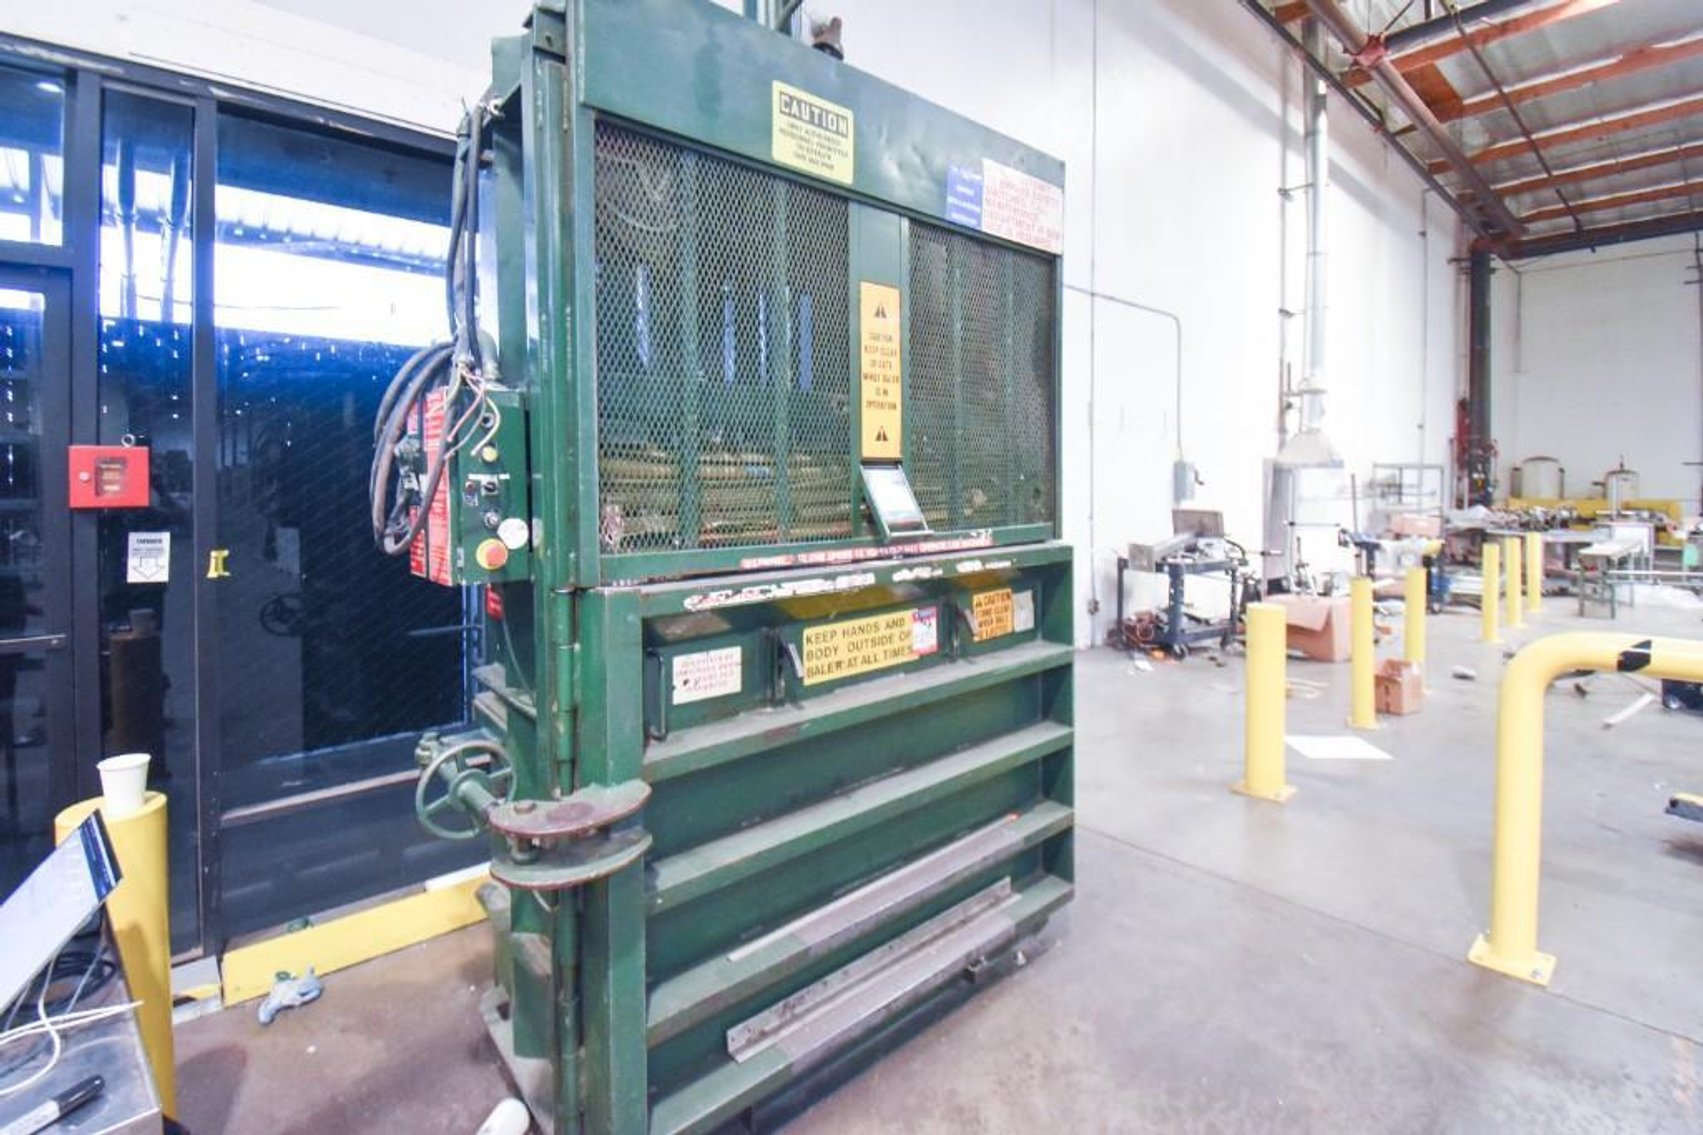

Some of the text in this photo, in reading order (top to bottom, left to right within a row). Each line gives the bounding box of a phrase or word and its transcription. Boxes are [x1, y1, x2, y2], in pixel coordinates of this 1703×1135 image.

[781, 94, 848, 135] CAUTION
[806, 629, 838, 646] KEEP
[842, 622, 880, 639] HANDS
[885, 617, 906, 630] AND
[806, 646, 839, 662] BODY
[847, 635, 893, 653] OUTSIDE
[806, 659, 843, 678] BALER
[847, 657, 858, 668] AT
[861, 653, 879, 666] ALL
